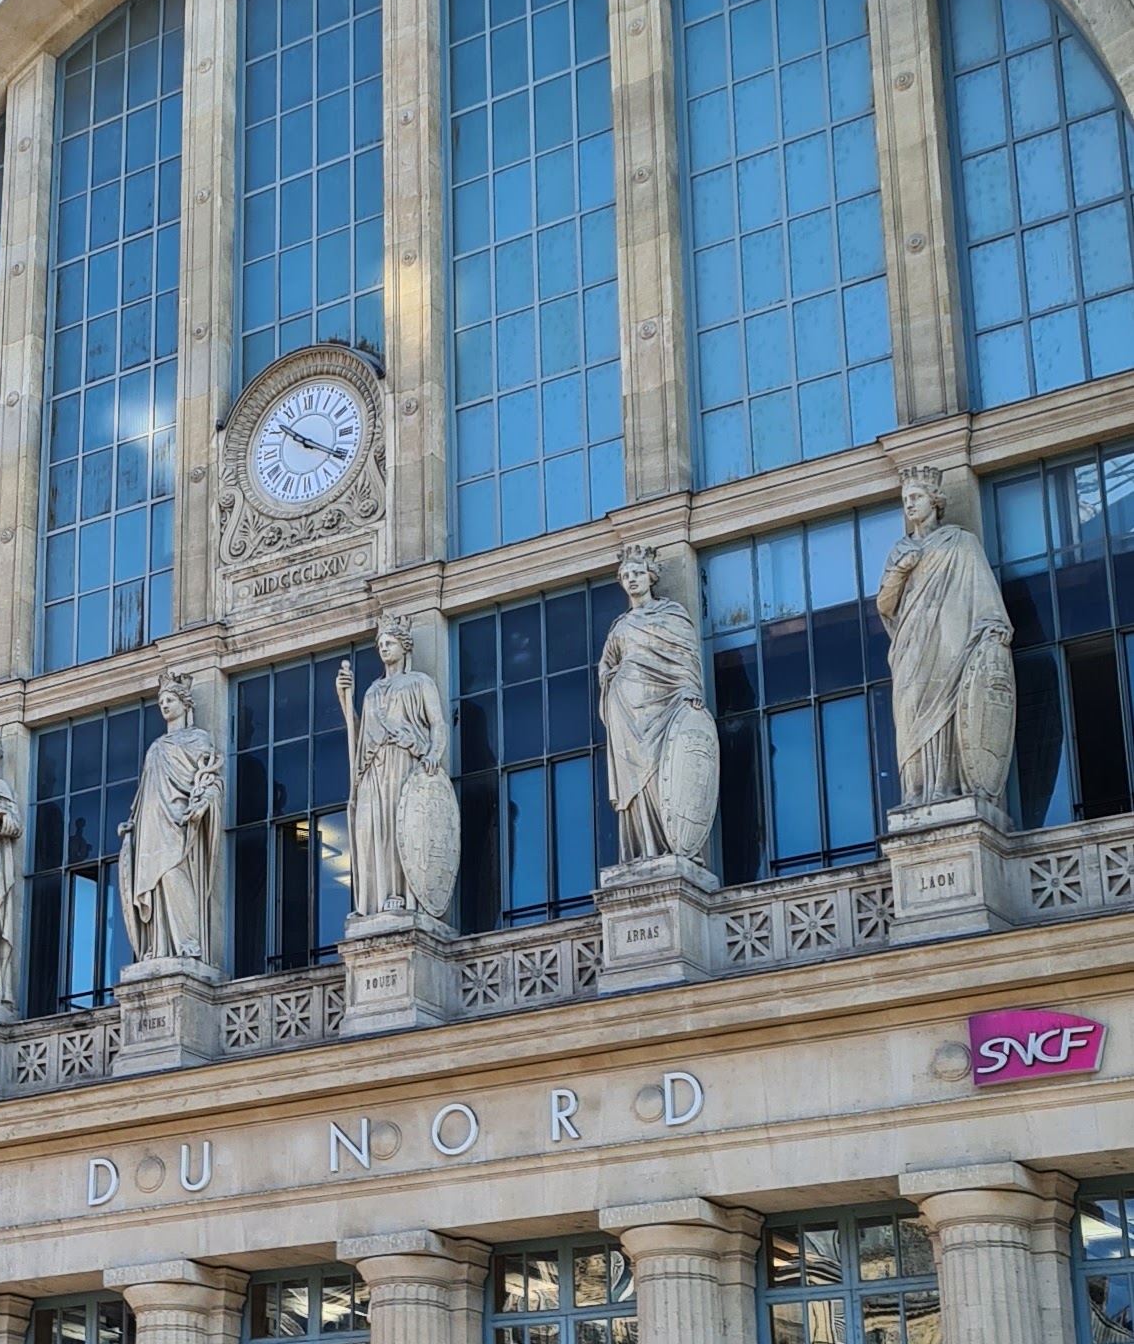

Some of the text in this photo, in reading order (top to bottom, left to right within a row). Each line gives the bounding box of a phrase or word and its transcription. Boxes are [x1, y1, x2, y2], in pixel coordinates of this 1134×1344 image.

[253, 554, 352, 597] MDCCCLXIV
[921, 871, 955, 890] LAON
[626, 925, 659, 943] ARRAS
[976, 1024, 1095, 1074] SNCF
[87, 1141, 212, 1206] DU
[329, 1071, 704, 1173] NORD
